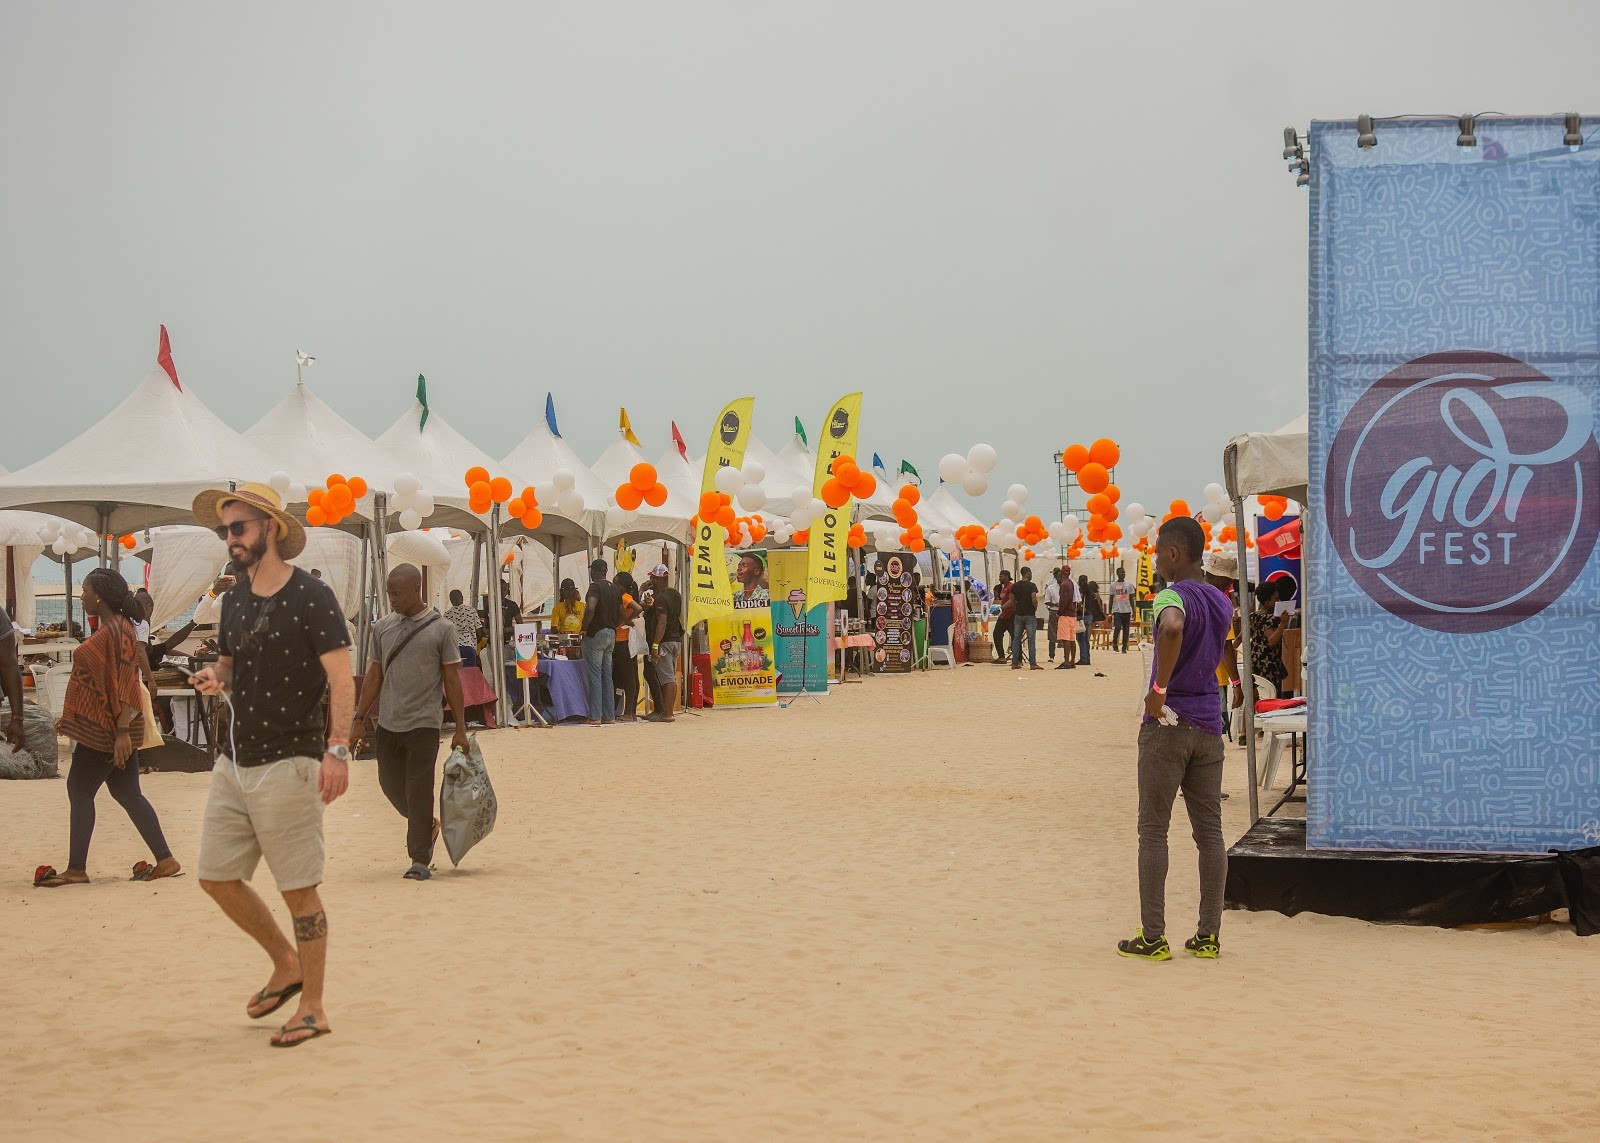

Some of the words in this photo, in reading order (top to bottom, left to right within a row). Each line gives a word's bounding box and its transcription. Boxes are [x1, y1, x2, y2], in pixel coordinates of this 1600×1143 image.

[1418, 532, 1518, 566] FEST
[734, 600, 769, 609] ADDICT
[715, 675, 774, 687] LEMONADE
